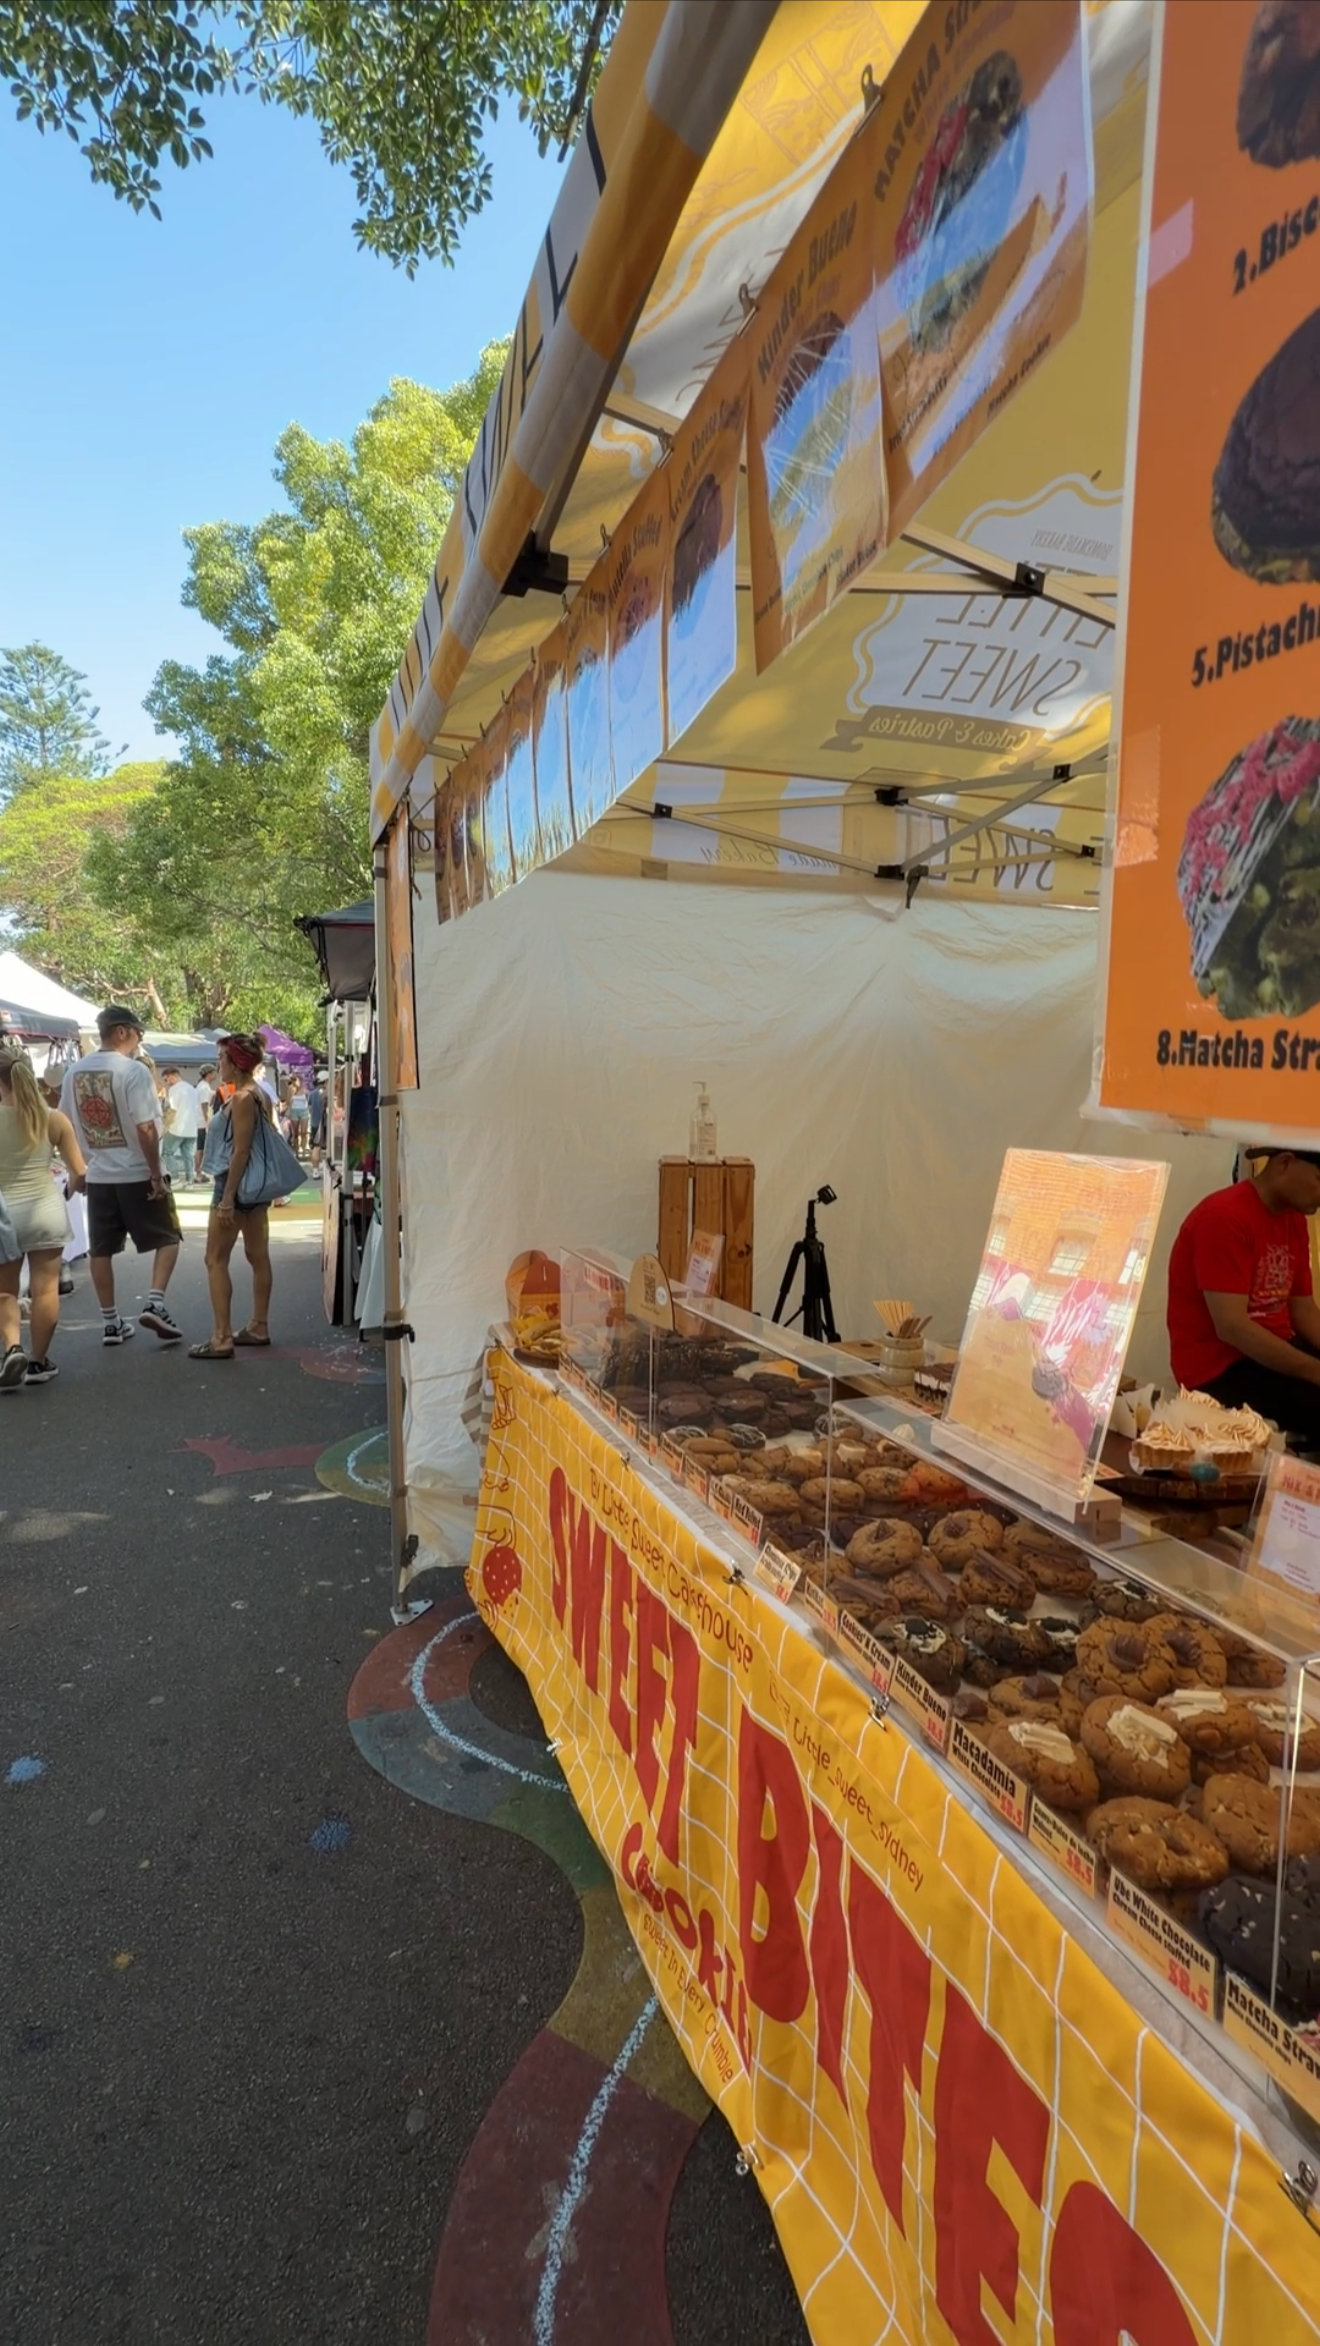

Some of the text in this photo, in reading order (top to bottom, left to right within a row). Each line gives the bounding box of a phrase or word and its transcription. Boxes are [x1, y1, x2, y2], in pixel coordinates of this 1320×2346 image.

[1156, 1029, 1264, 1069] 8.Matcha
[549, 1466, 700, 1868] SWEET
[870, 1639, 891, 1672] Cream
[896, 1660, 923, 1697] Kinder
[923, 1688, 947, 1723] Bueno
[951, 1742, 970, 1769] White
[953, 1722, 1017, 1799] Macadamia
[1113, 1875, 1132, 1902] Ube
[1132, 1888, 1161, 1926] White
[1161, 1918, 1211, 1973] Chocolate
[1168, 1956, 1210, 2014] $8.5
[1228, 1978, 1279, 2041] Matcha
